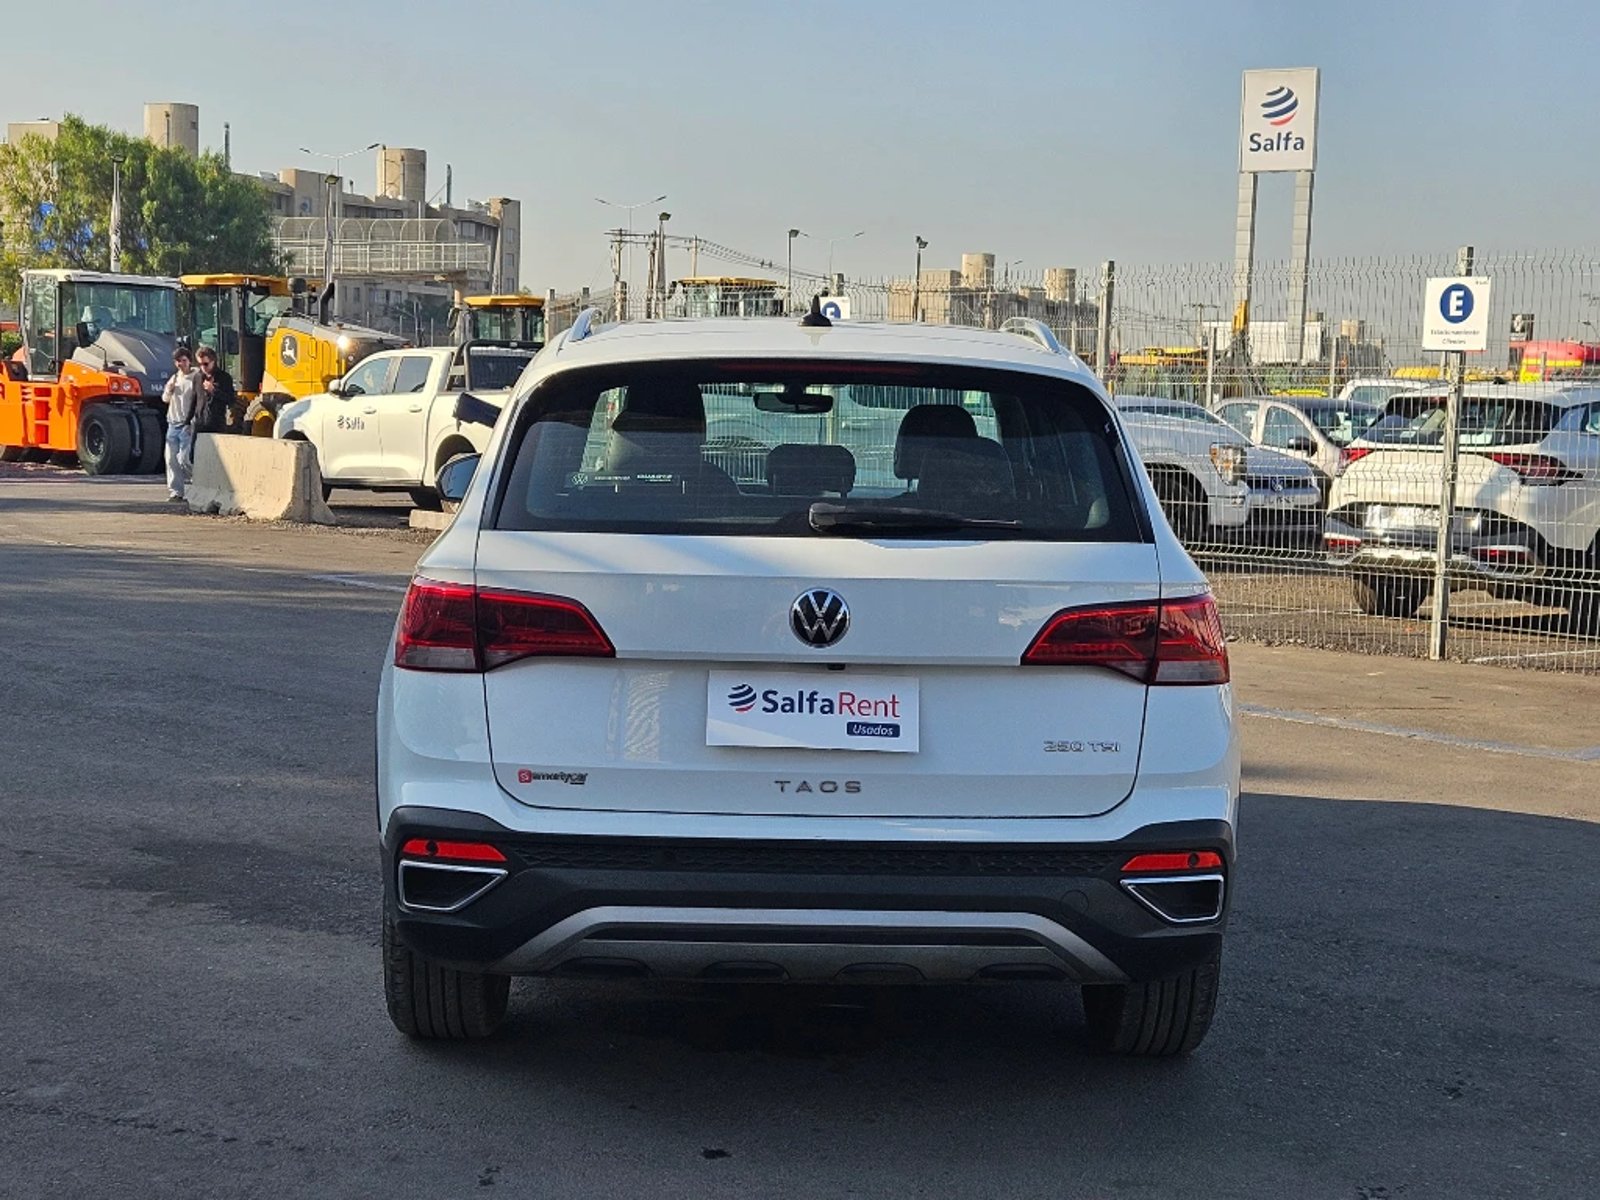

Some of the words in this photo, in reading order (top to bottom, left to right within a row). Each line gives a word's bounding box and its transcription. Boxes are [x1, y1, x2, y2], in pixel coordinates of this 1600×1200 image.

[1249, 131, 1305, 152] Salfa
[1449, 289, 1465, 317] E
[852, 723, 894, 736] Usados
[774, 780, 862, 793] TAOS
